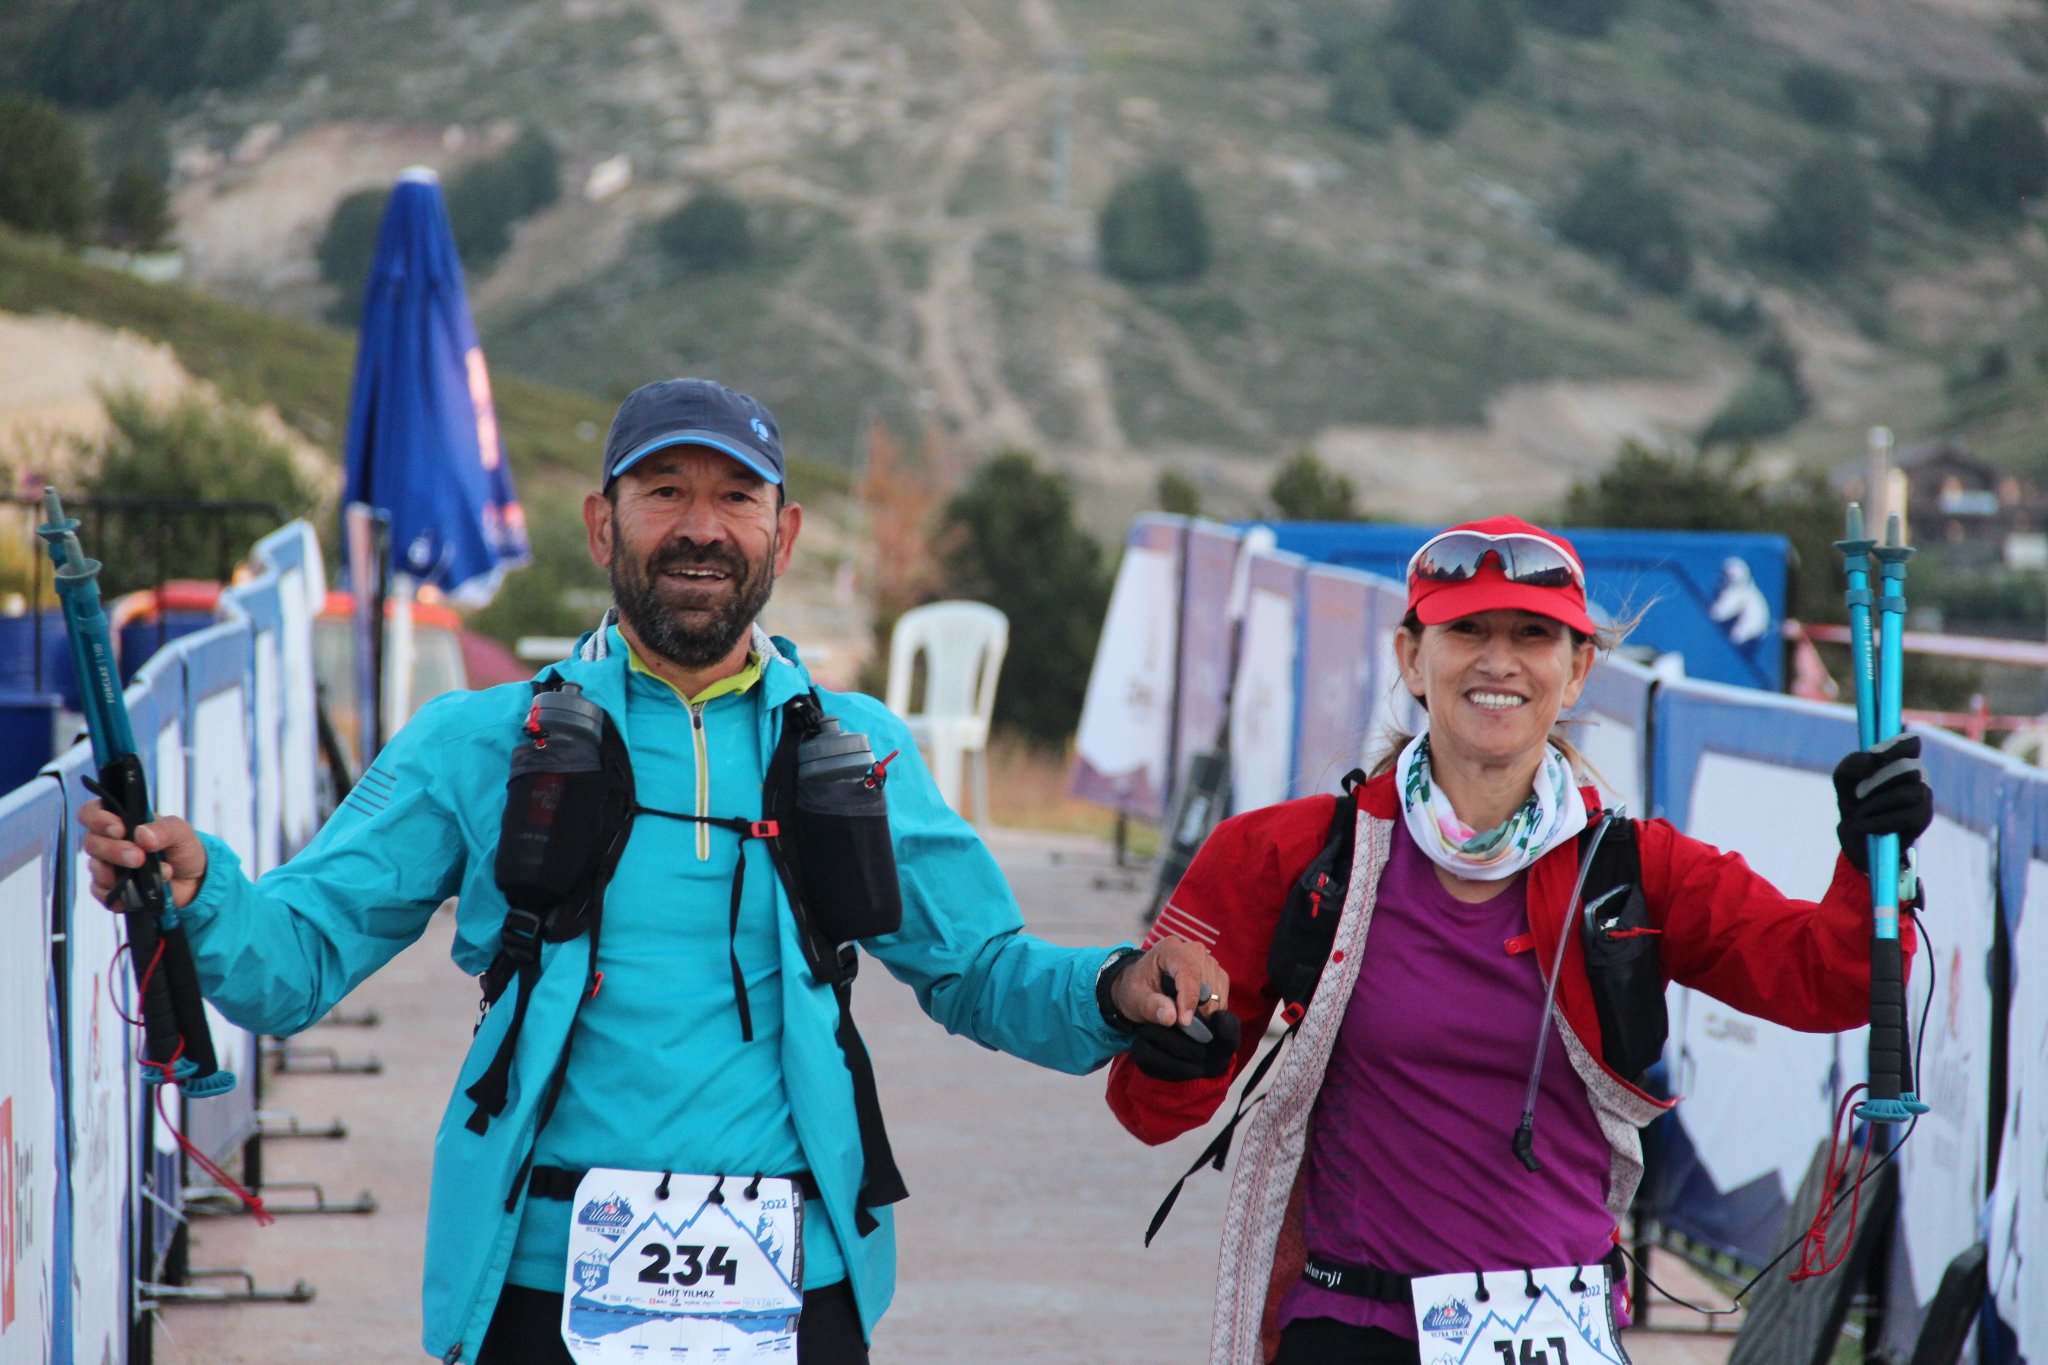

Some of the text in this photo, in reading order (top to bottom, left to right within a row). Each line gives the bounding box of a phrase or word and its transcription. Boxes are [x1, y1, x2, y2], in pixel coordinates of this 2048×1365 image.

[98, 666, 116, 704] FORCLAZ
[760, 1198, 788, 1210] 2022
[608, 1226, 627, 1235] TRAIL
[638, 1243, 738, 1287] 234
[1304, 1261, 1342, 1288] alenji
[682, 1289, 715, 1299] YILMAZ
[1494, 1337, 1569, 1365] 141
